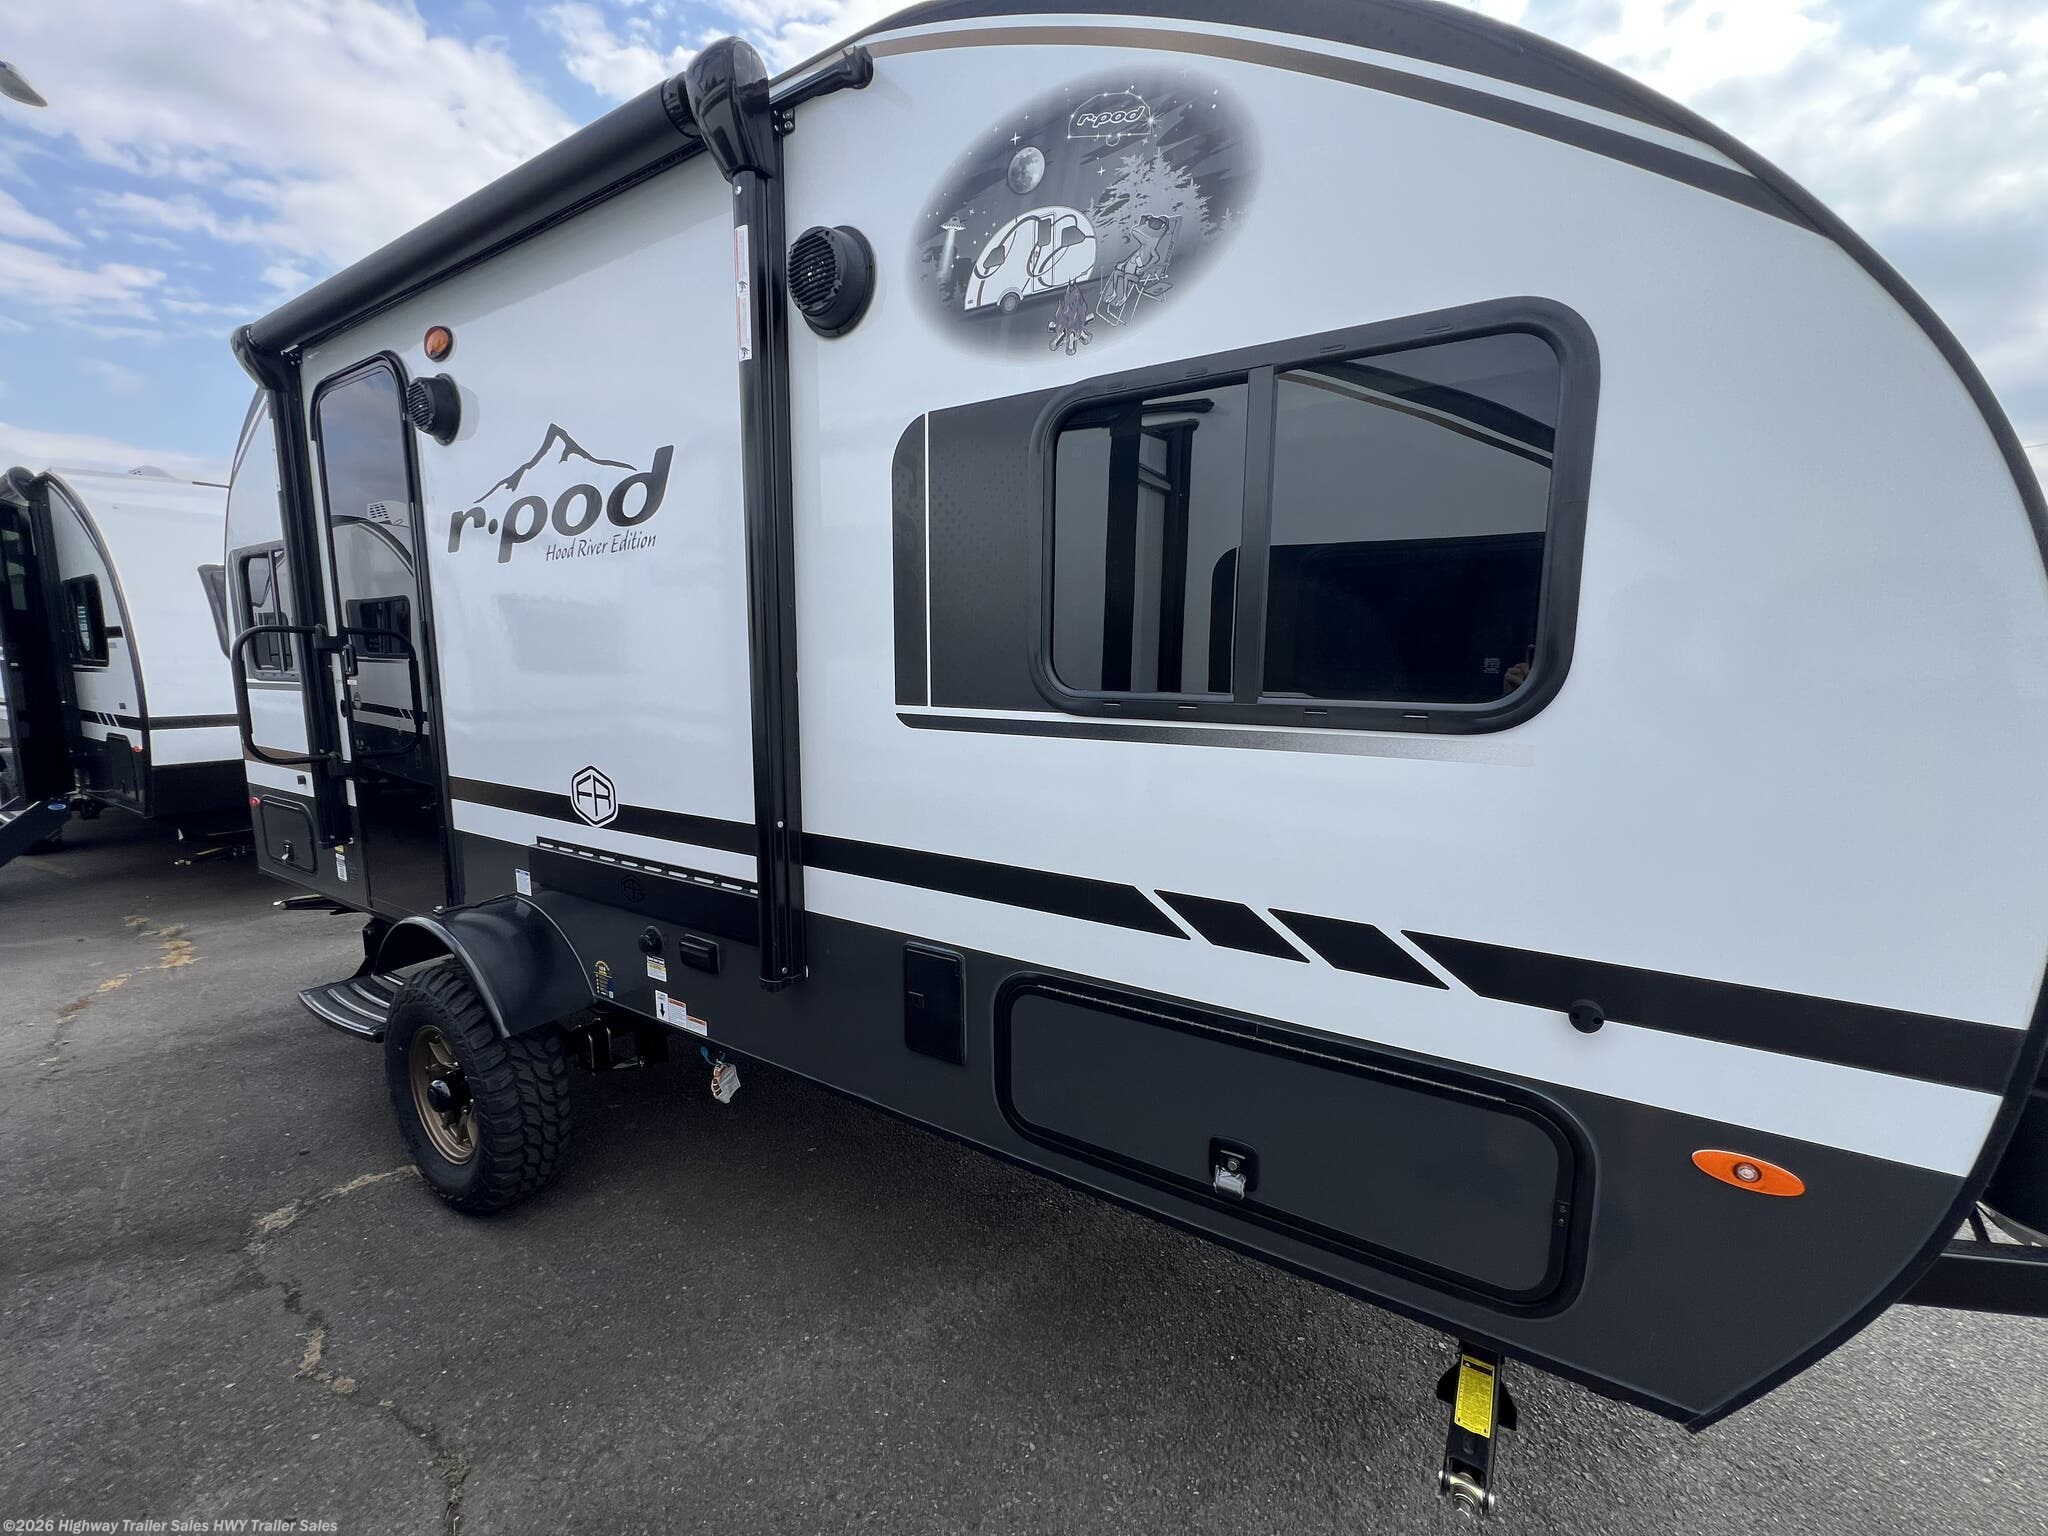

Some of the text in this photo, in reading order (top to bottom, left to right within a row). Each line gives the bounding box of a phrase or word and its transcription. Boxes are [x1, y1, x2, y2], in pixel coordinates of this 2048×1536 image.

[545, 529, 657, 561] Hood River Edition
